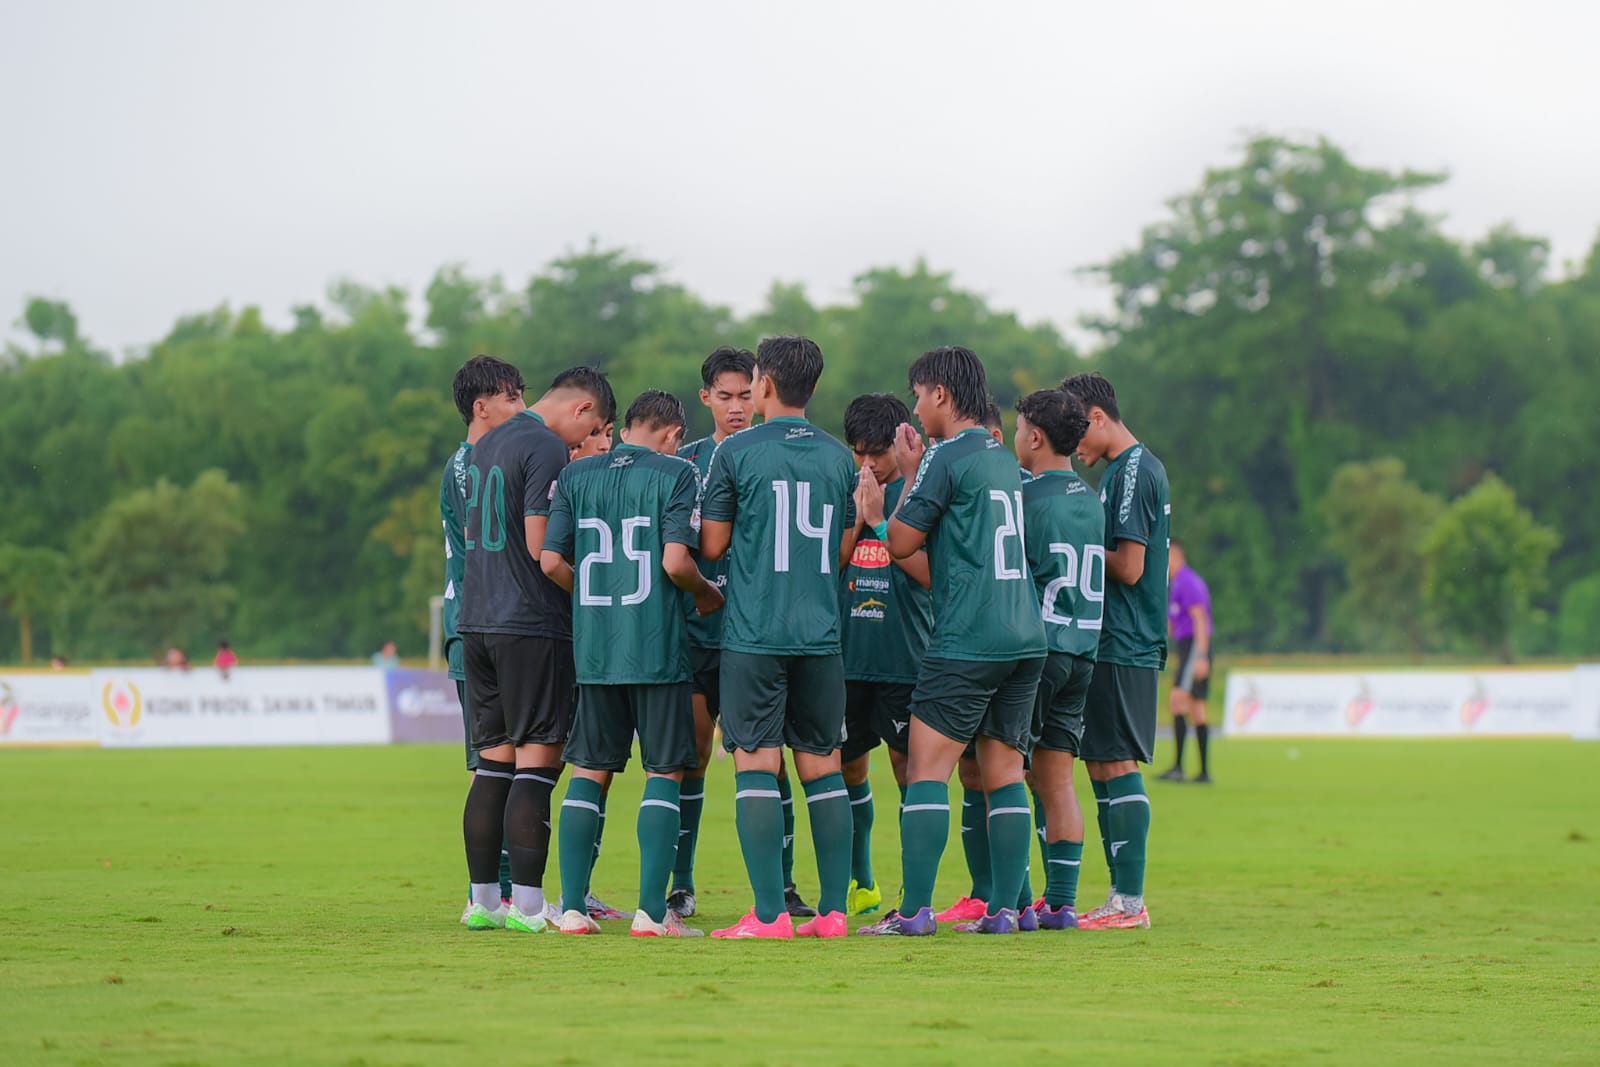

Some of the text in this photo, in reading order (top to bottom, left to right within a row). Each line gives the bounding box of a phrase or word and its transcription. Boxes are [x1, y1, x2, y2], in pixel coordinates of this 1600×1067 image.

[464, 464, 507, 551] 20
[772, 480, 834, 574] 14
[578, 516, 651, 606] 25
[855, 578, 890, 590] mangga
[1041, 542, 1105, 630] 29
